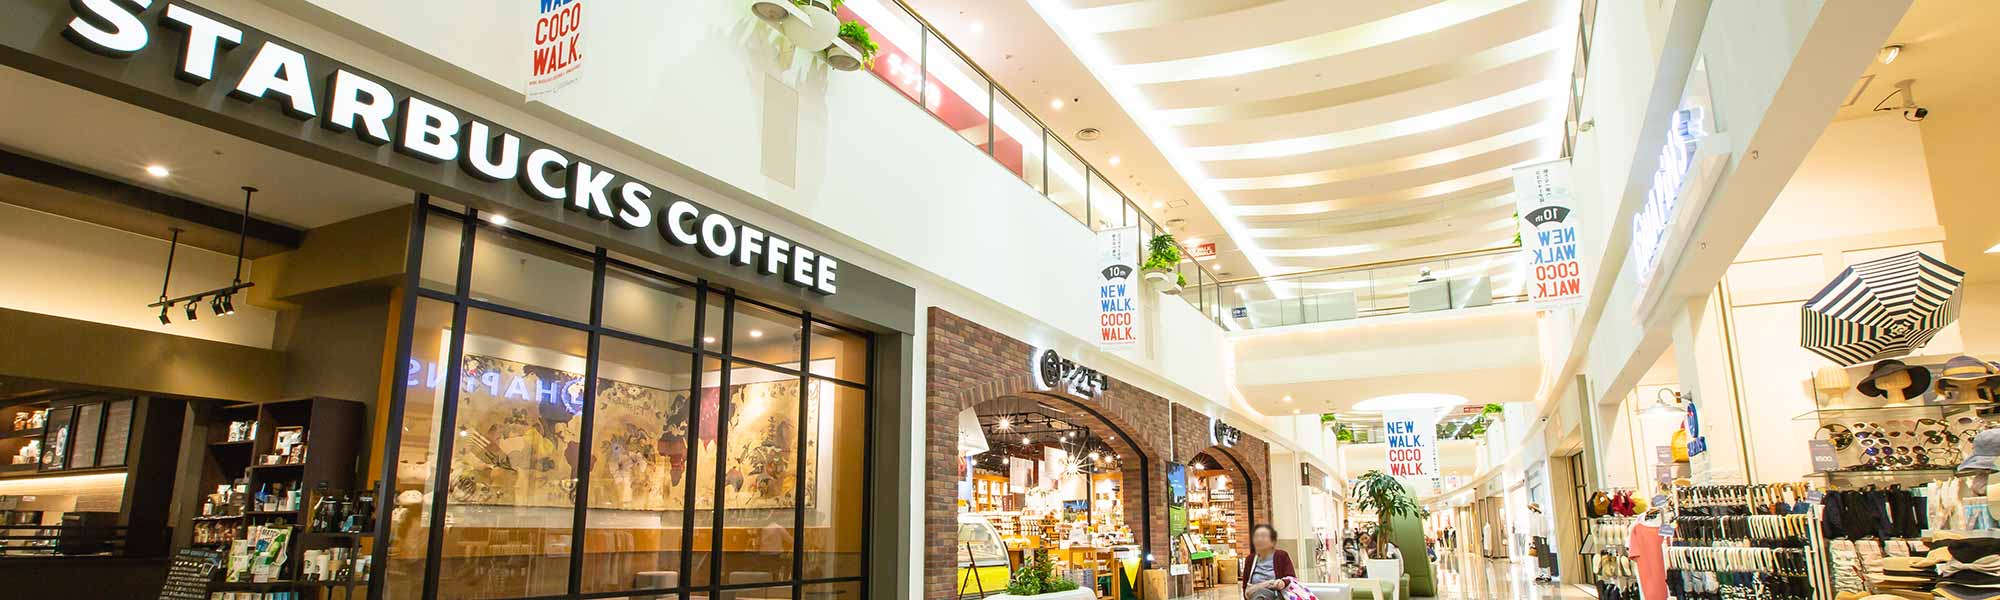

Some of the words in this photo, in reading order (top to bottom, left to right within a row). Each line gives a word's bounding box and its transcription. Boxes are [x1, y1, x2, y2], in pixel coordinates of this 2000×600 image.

[535, 2, 582, 46] COCO
[533, 33, 582, 77] WALK.
[67, 0, 653, 229] STARBUCKS
[664, 201, 838, 296] COFFEE
[1100, 284, 1126, 298] NEW
[1100, 298, 1135, 312] WALK.
[1100, 312, 1131, 327] COCO
[1101, 327, 1136, 341] WALK.
[1387, 421, 1414, 434] NEW
[1388, 434, 1425, 448] WALK.
[1389, 448, 1422, 462] COCO
[1390, 462, 1428, 476] WALK.
